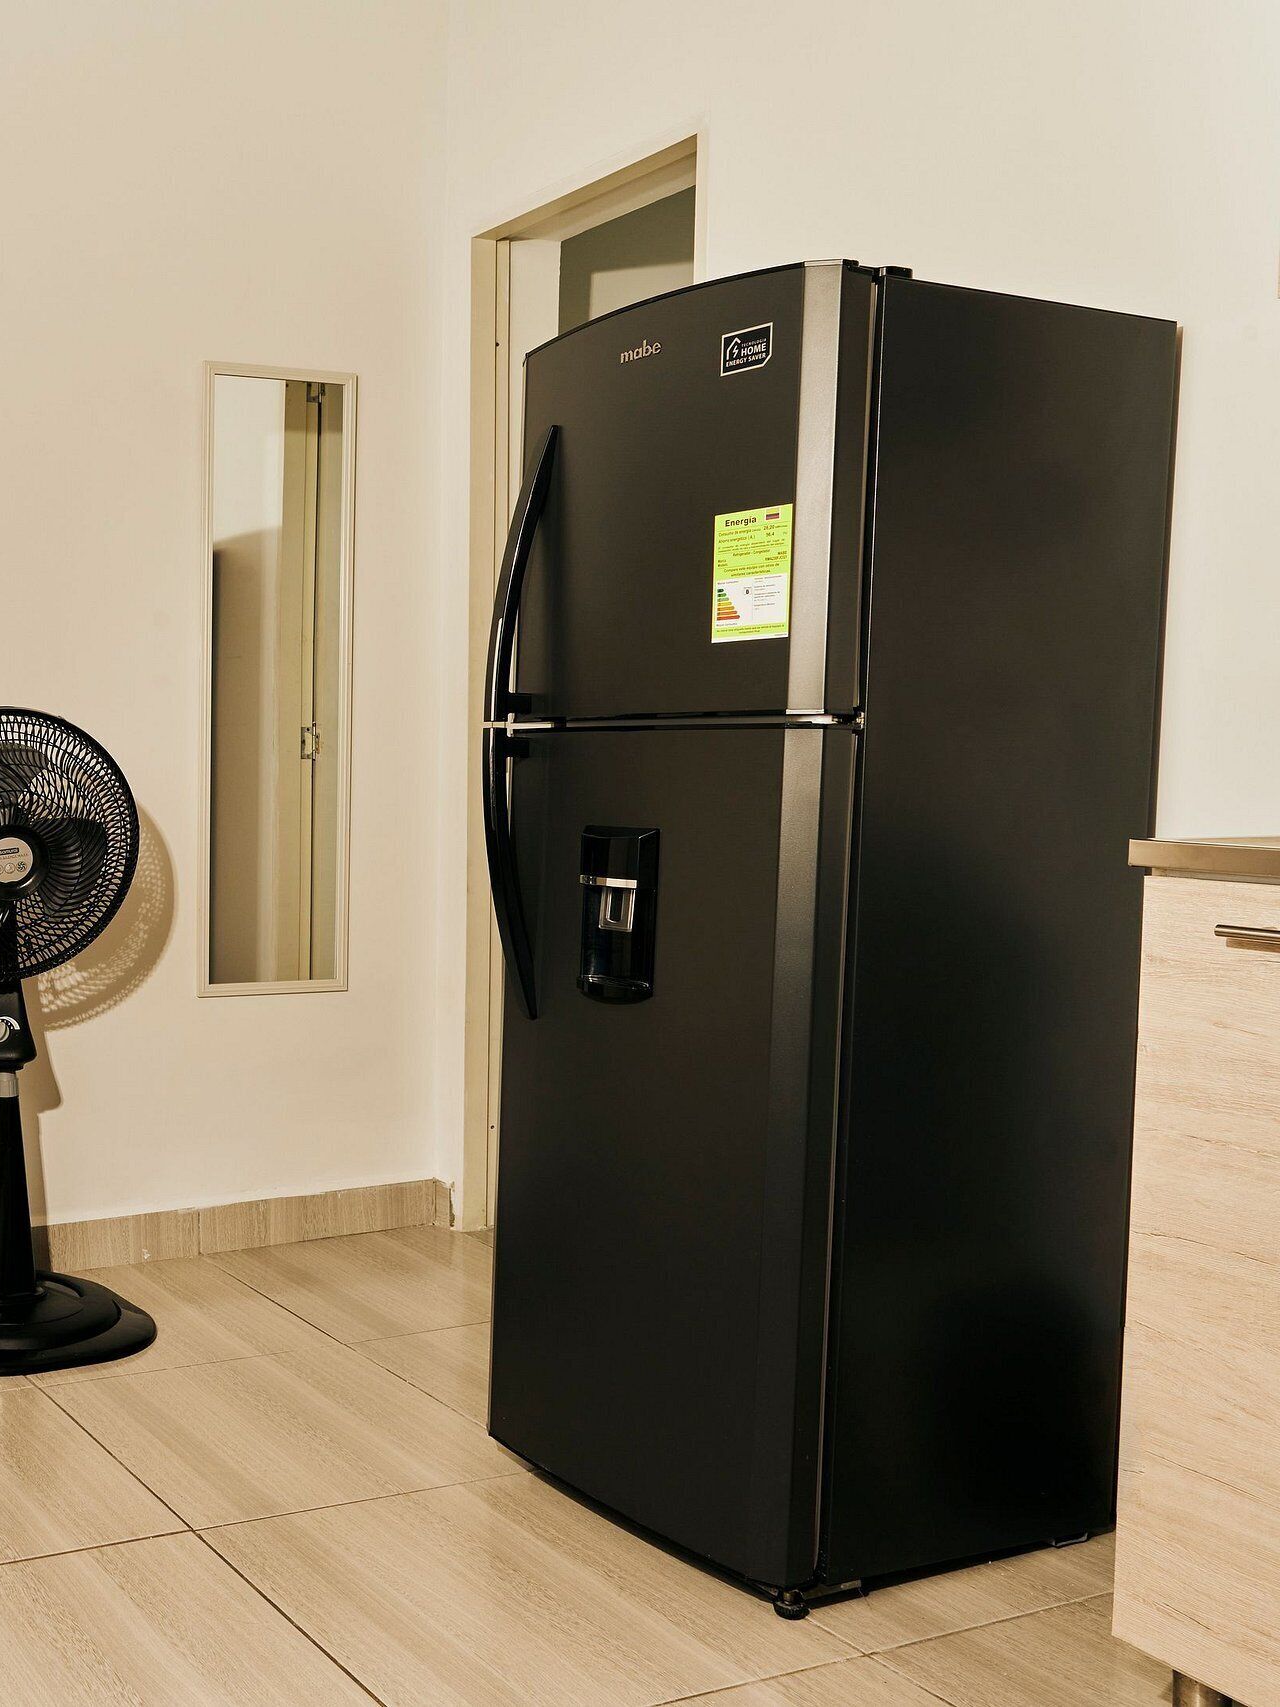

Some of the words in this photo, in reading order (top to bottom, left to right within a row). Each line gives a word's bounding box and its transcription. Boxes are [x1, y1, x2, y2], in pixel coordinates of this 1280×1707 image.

[620, 339, 662, 363] mabe
[740, 342, 767, 357] HOME
[725, 357, 747, 368] ENERGY
[748, 352, 767, 363] SAVER
[725, 516, 757, 528] Energía
